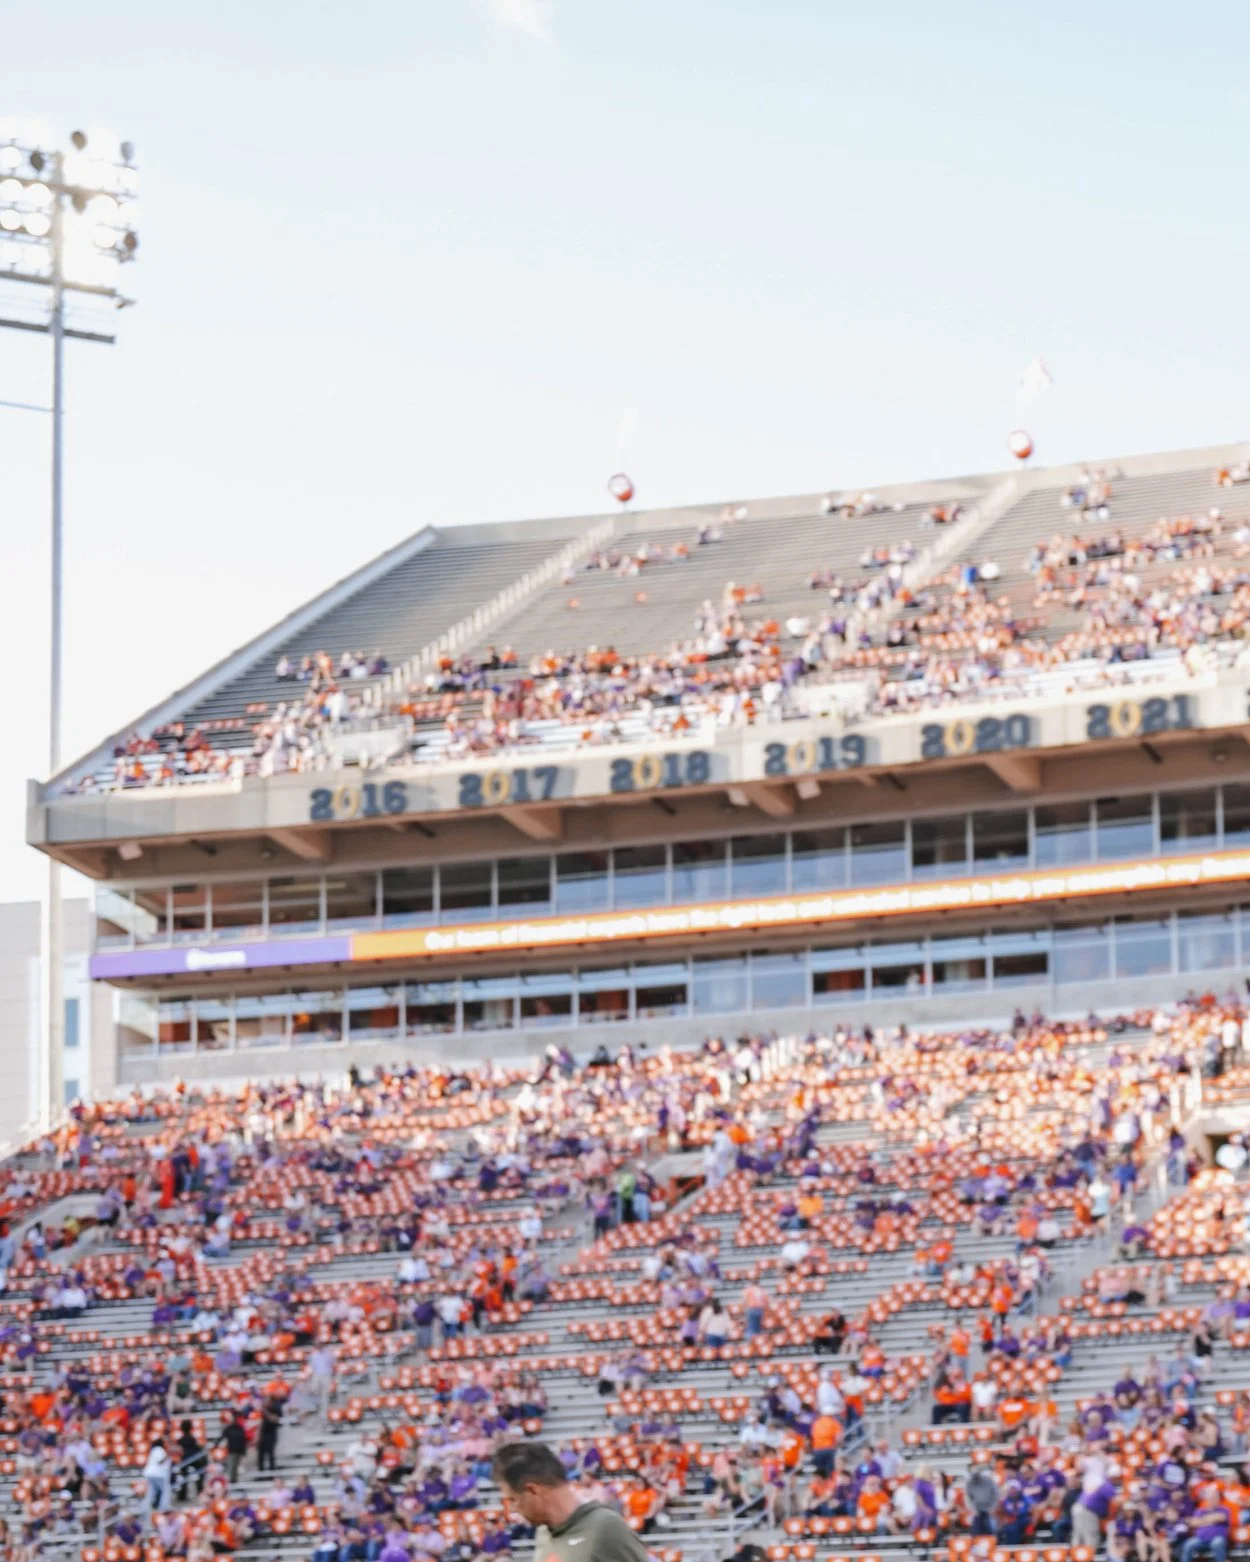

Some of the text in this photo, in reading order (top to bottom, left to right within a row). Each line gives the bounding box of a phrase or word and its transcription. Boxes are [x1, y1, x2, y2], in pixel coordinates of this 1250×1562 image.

[310, 781, 407, 822] 2016
[459, 766, 560, 807] 2017
[610, 751, 710, 793] 2018
[764, 735, 867, 777] 2019
[921, 714, 1033, 758] 2020
[1086, 693, 1193, 738] 2021
